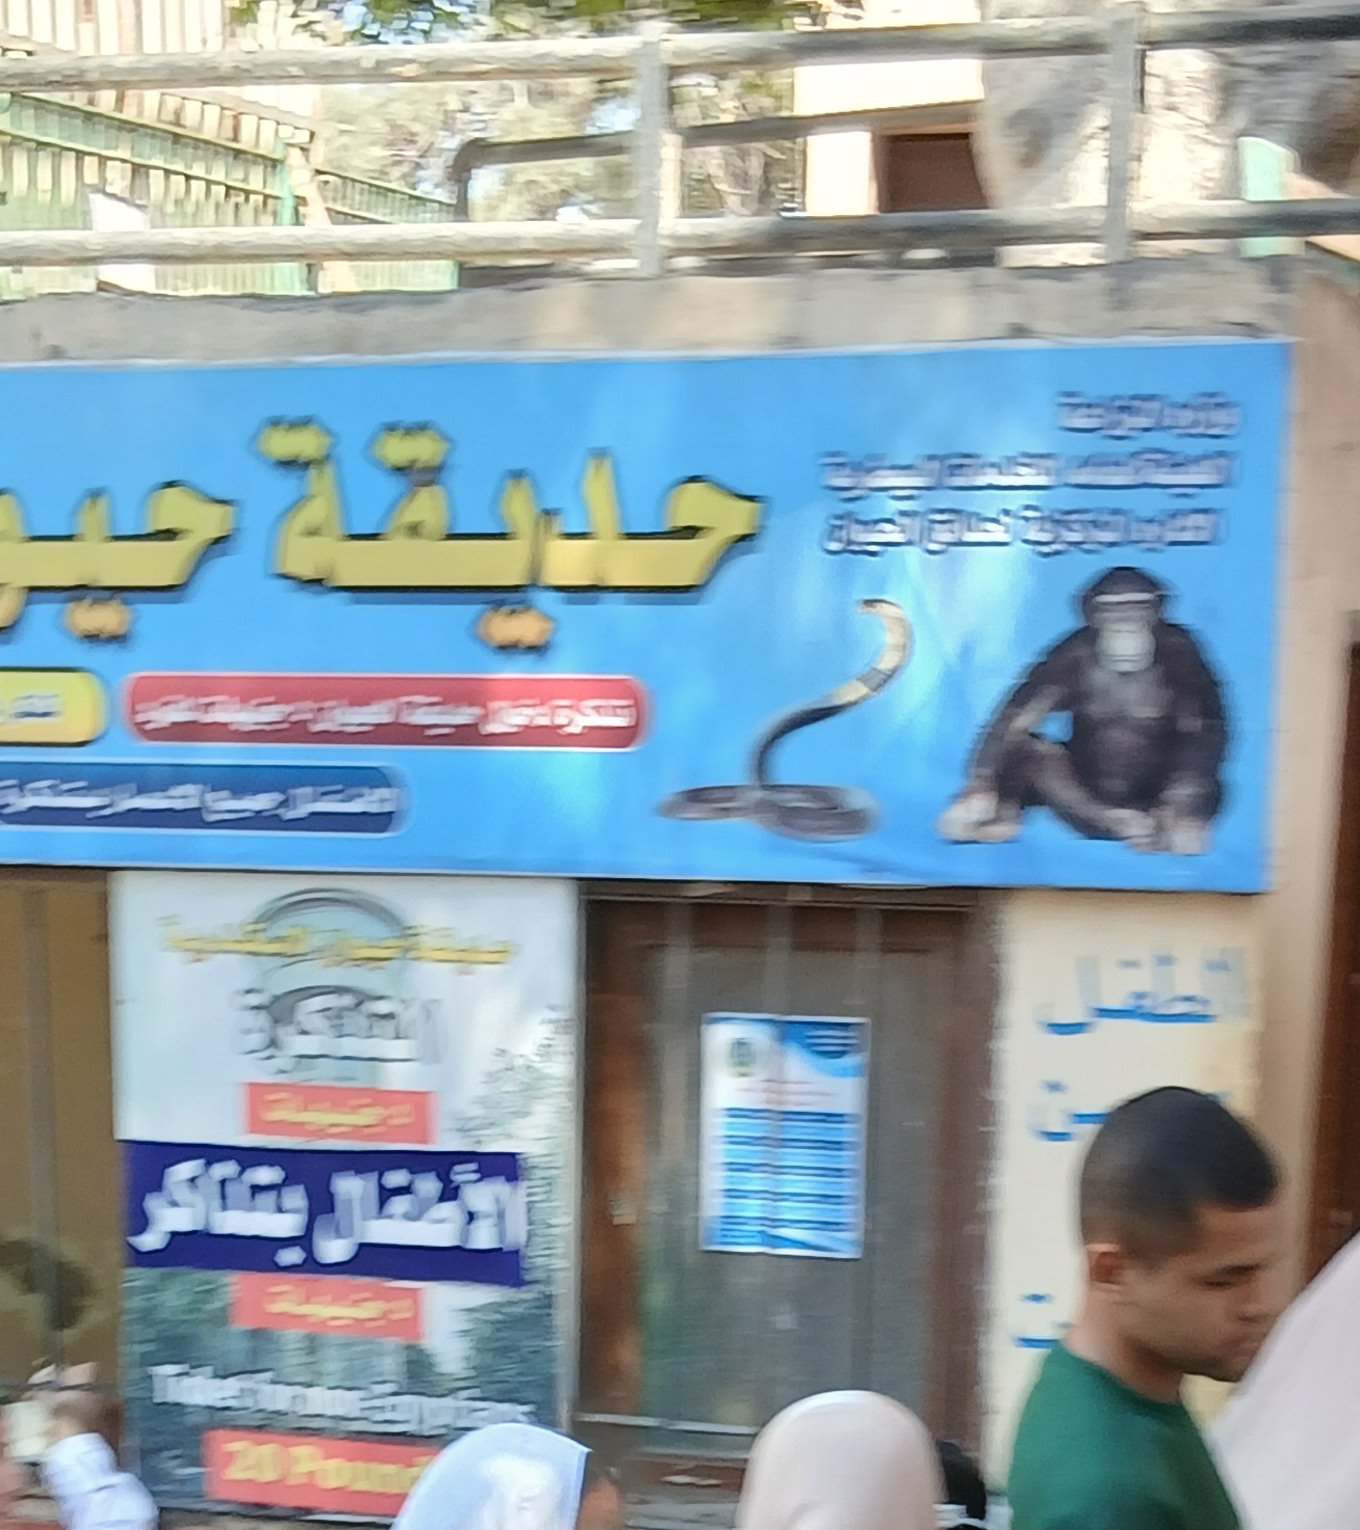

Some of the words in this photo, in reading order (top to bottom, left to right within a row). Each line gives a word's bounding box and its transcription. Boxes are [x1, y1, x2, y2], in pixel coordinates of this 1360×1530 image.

[251, 413, 766, 655] حديقة
[126, 1158, 309, 1268] بتذاكر
[311, 1161, 528, 1265] الأطفال
[220, 1440, 285, 1482] 20
